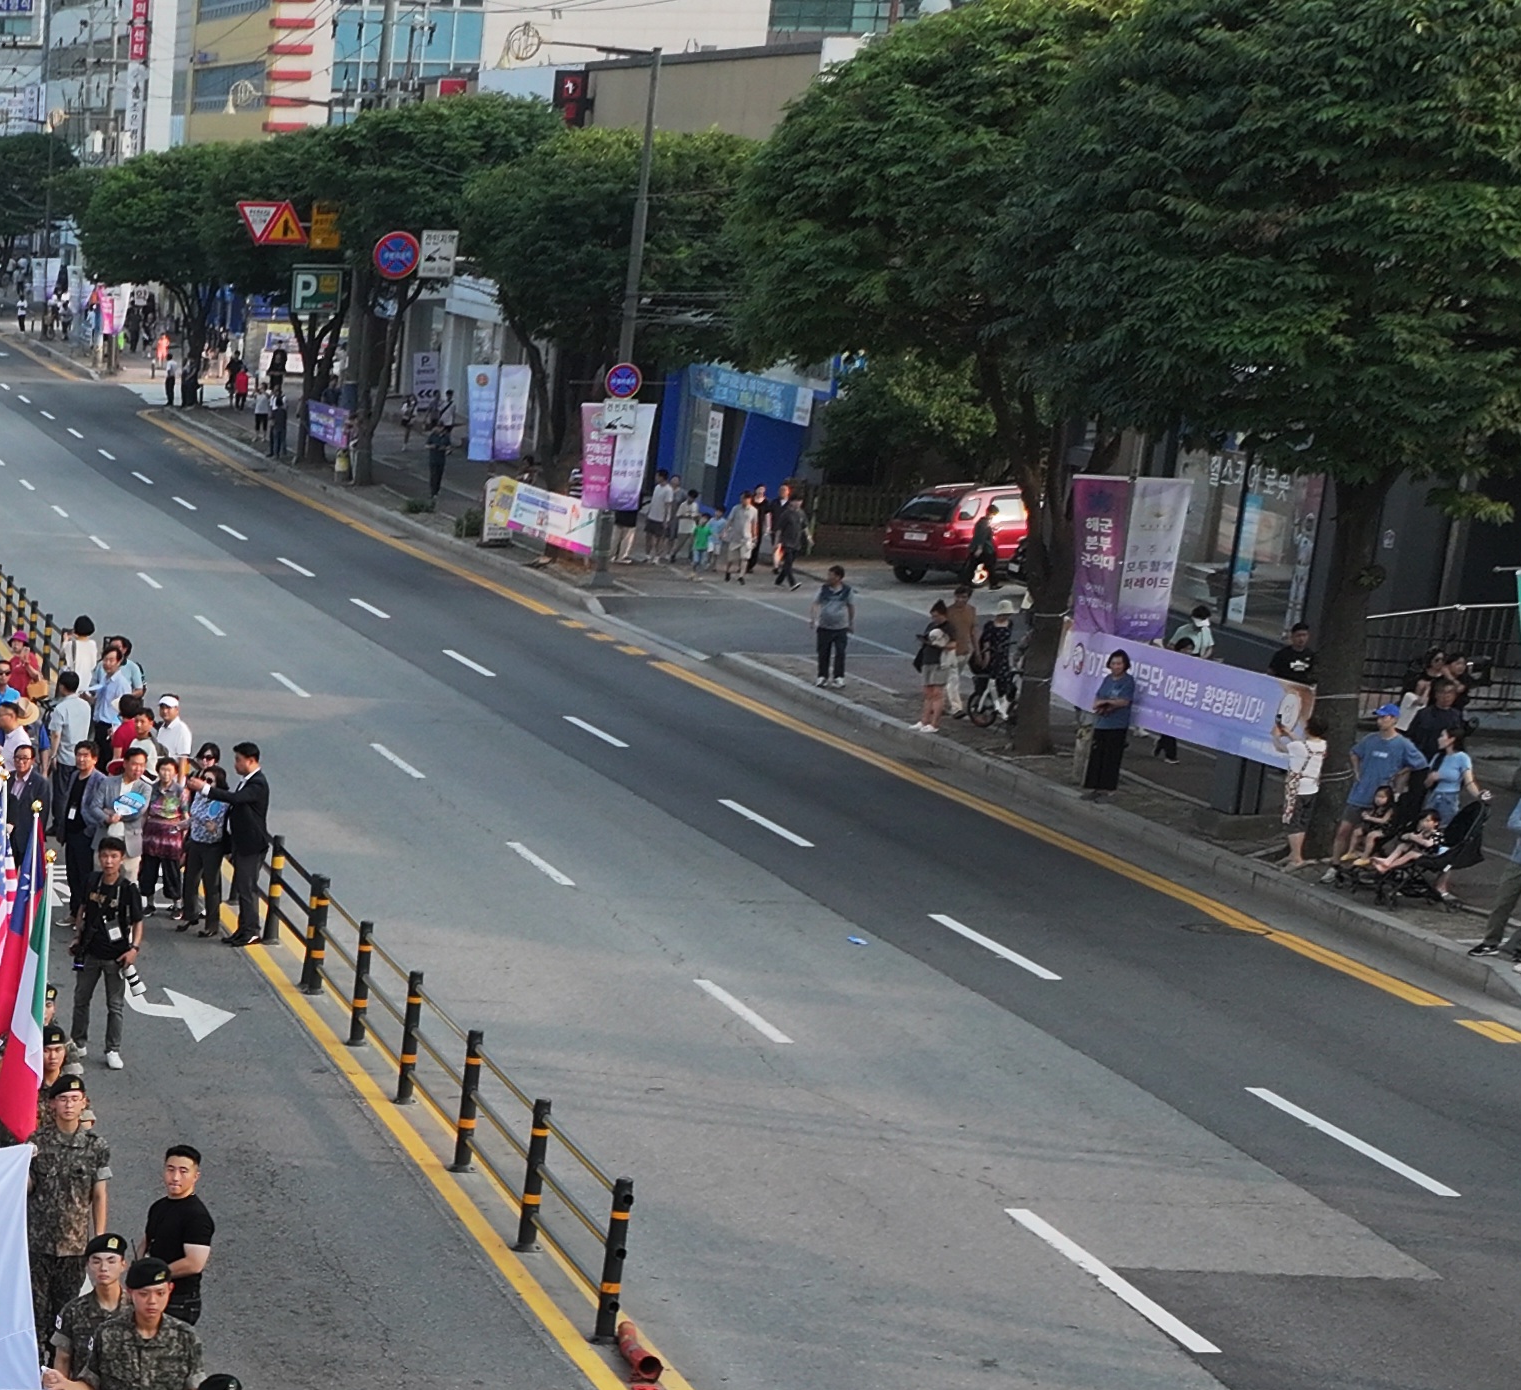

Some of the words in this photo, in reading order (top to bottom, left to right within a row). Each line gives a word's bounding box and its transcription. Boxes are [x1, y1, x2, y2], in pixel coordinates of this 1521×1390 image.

[295, 273, 318, 309] P
[1085, 516, 1114, 534] 해군
[1084, 535, 1113, 552] 본부
[1080, 551, 1116, 572] 군악대
[1201, 685, 1266, 724] 환영합니다!
